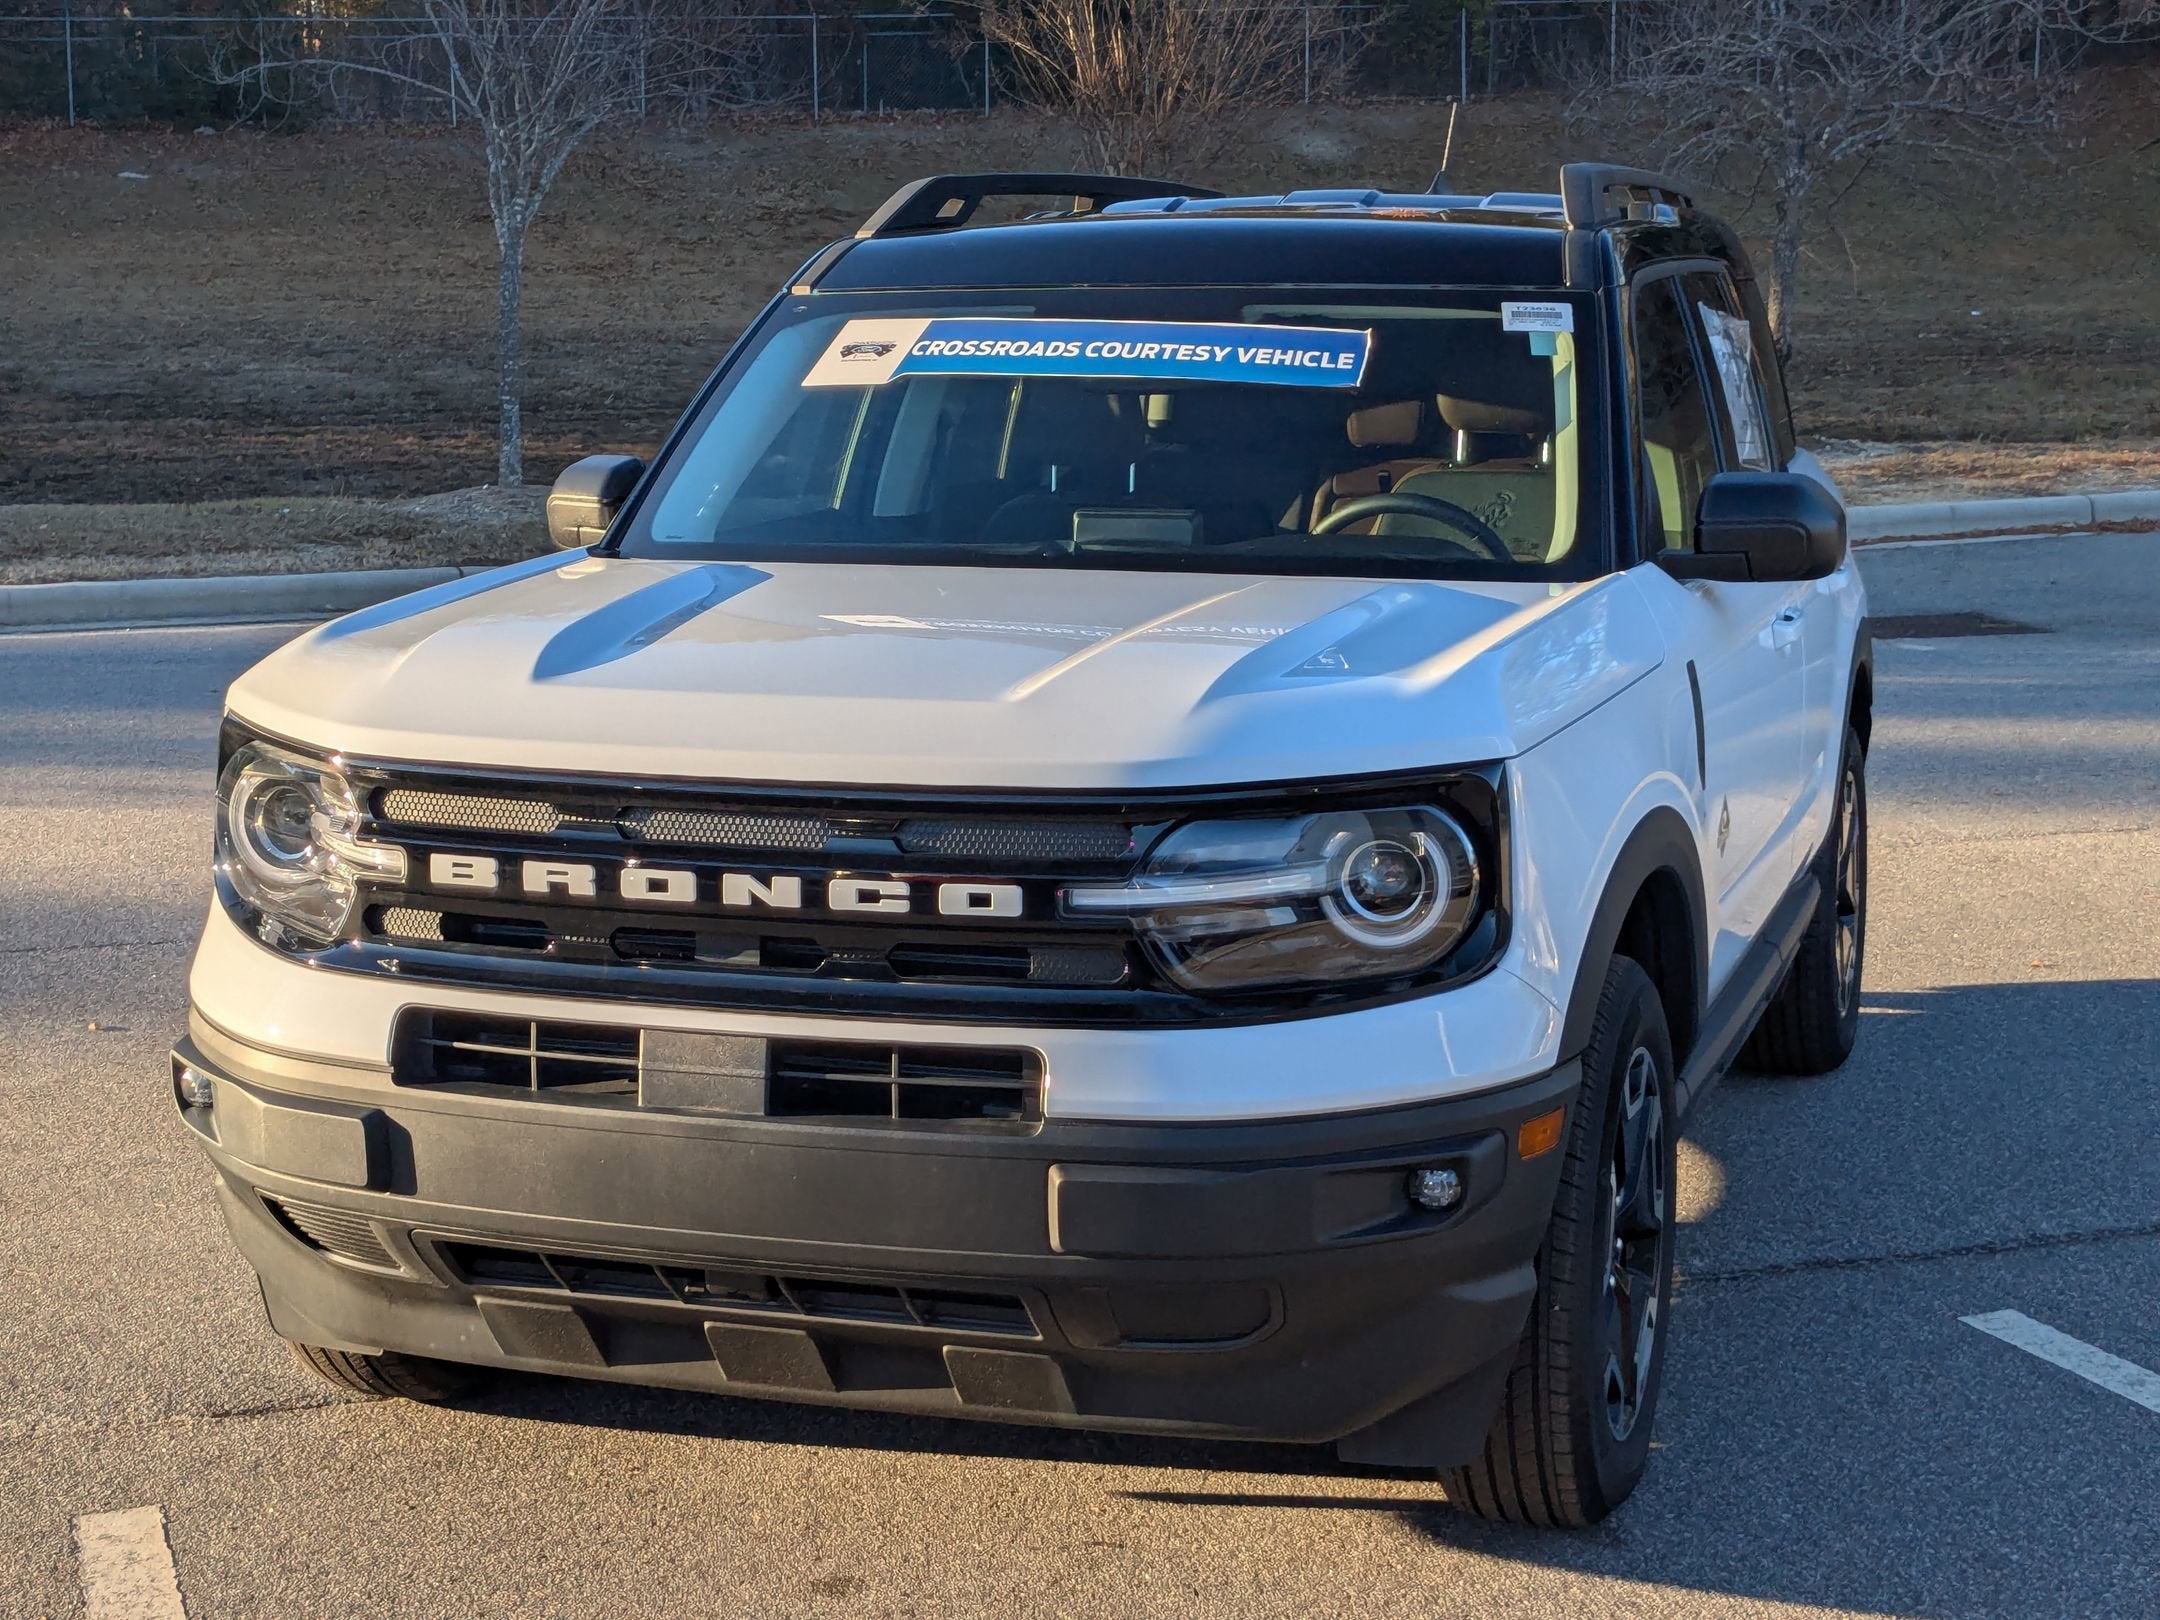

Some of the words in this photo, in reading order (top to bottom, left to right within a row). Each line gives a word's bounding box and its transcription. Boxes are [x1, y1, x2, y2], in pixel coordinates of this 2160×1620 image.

[912, 340, 1083, 357] CROSSROADS
[1084, 341, 1233, 362] COURTESY
[1237, 347, 1355, 369] VEHICLE
[429, 853, 1024, 917] BRONCO
